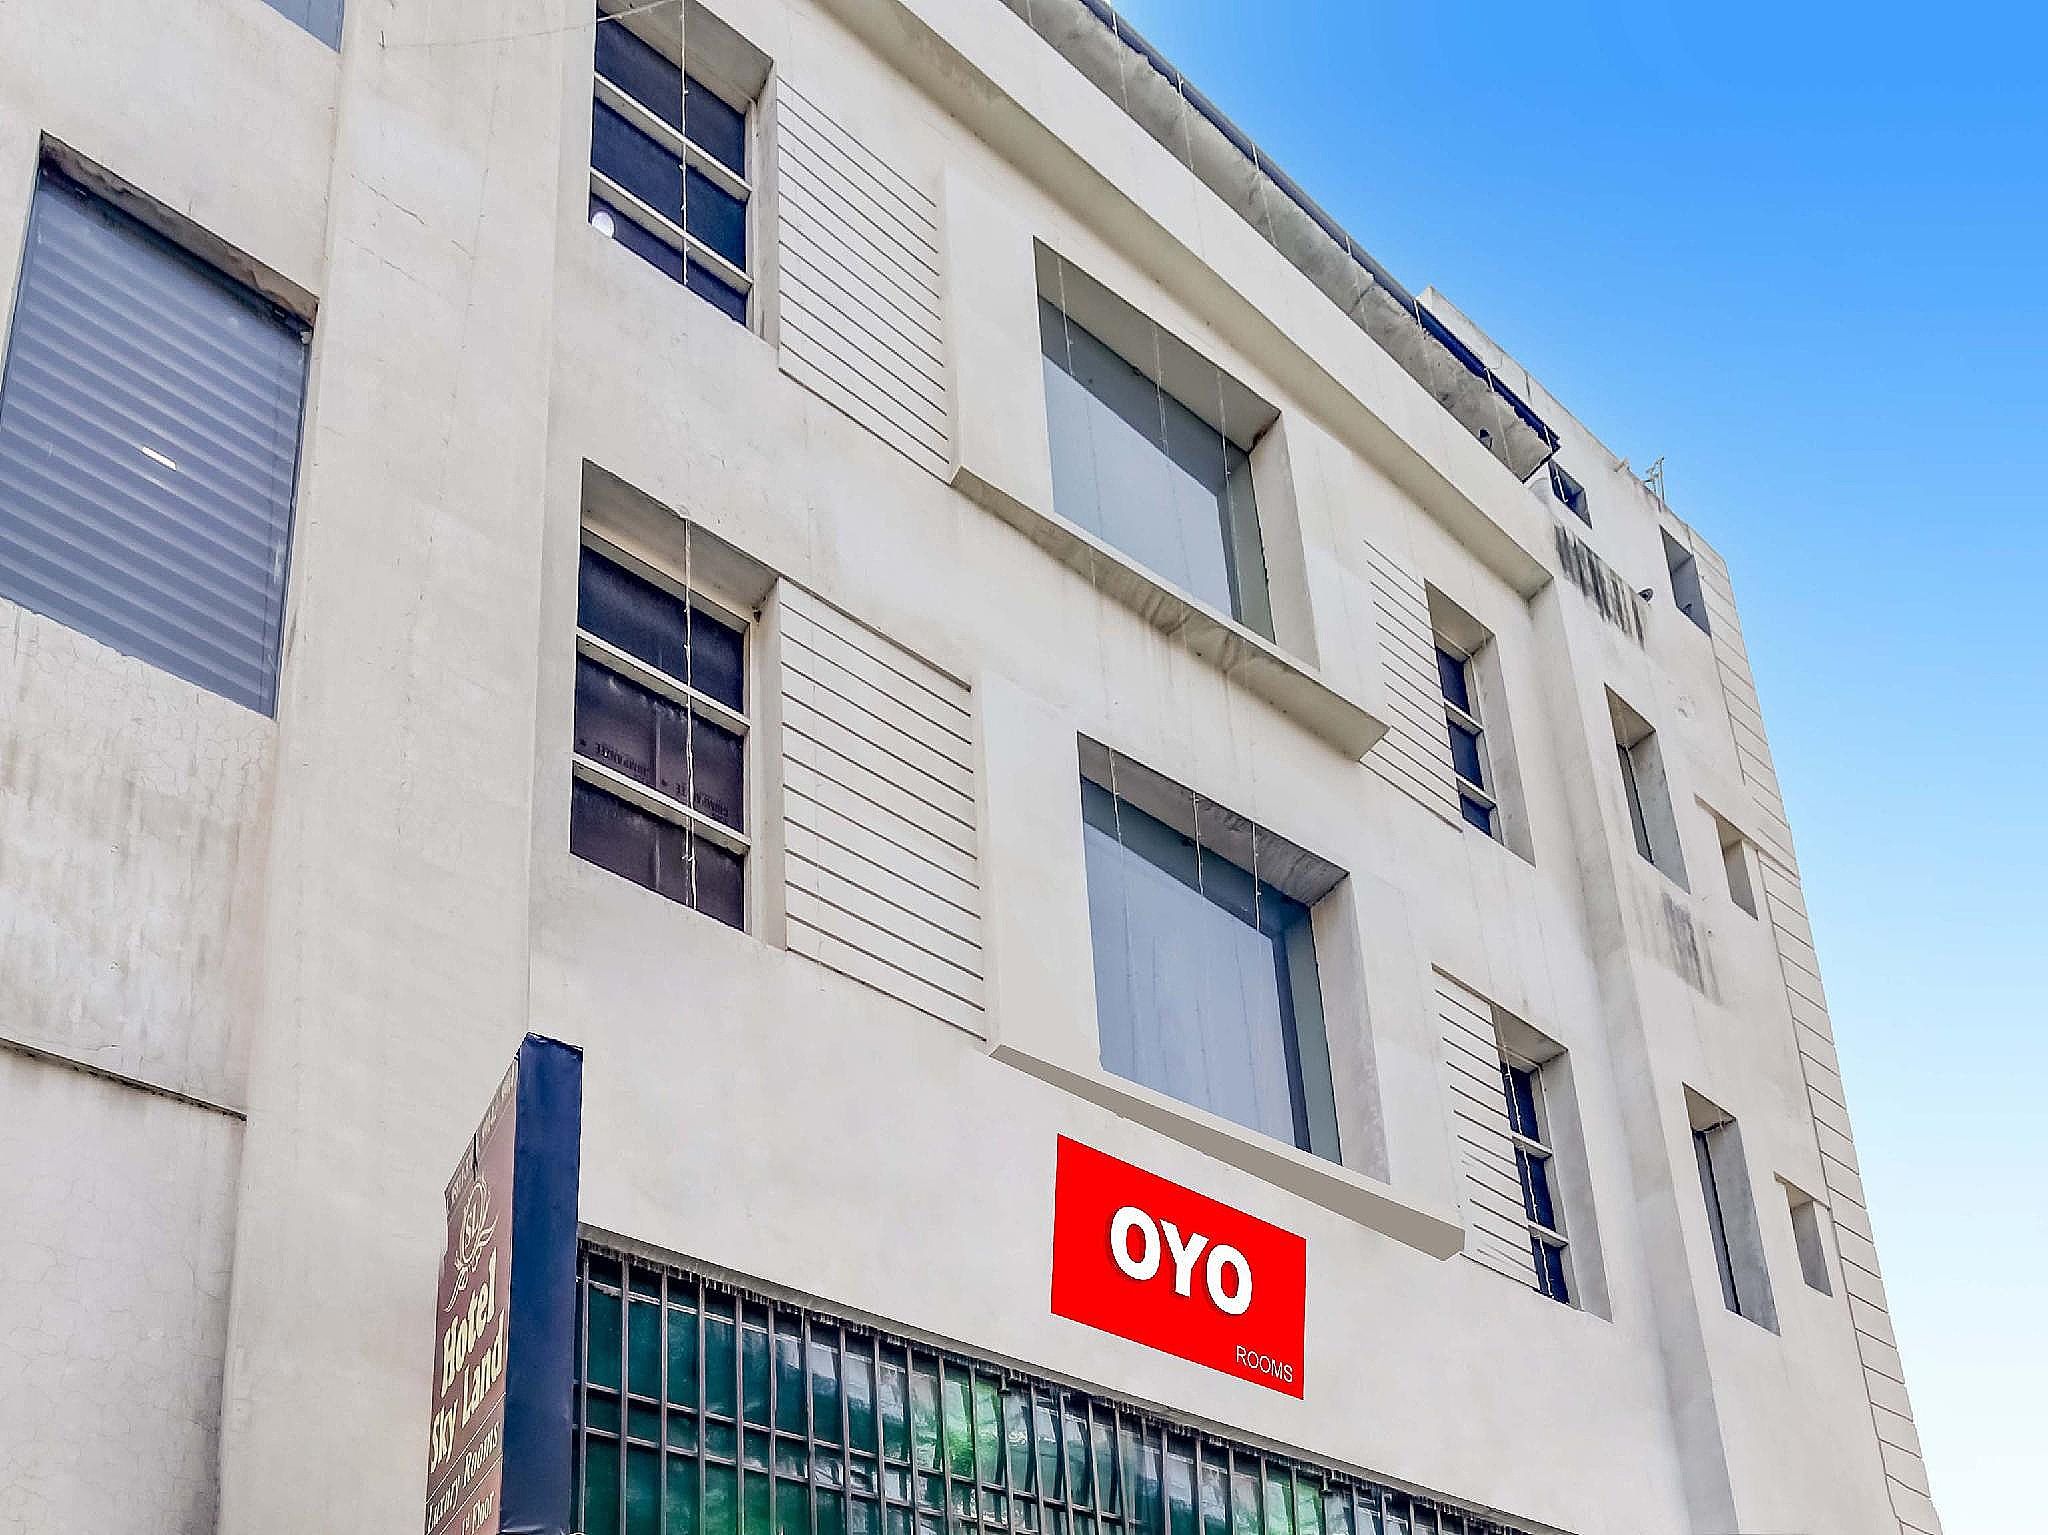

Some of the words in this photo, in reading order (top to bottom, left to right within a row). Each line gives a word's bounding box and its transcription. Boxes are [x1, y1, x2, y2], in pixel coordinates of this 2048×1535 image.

[464, 1202, 480, 1248] SL
[1110, 1206, 1253, 1316] OYO
[441, 1247, 497, 1398] Hotel
[1236, 1345, 1294, 1383] ROOMS
[430, 1399, 458, 1473] Sky
[461, 1308, 504, 1428] Land
[427, 1475, 460, 1534] Luxury
[463, 1421, 500, 1489] Rooms
[472, 1490, 495, 1535] Floor
